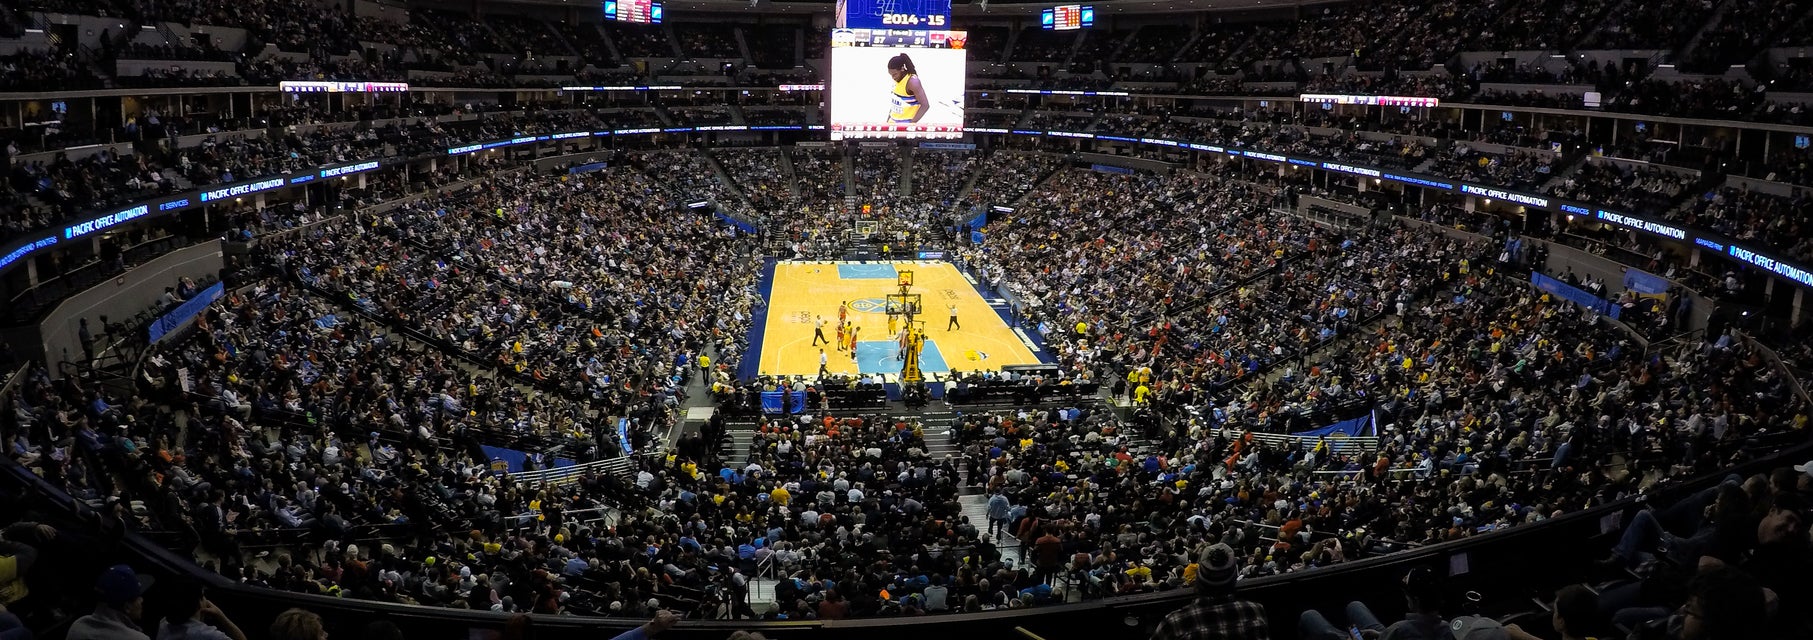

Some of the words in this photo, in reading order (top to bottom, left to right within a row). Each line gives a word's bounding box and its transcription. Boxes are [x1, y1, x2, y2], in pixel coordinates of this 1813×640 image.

[882, 14, 918, 25] 2014
[1354, 167, 1380, 176] AUTOMATION
[208, 189, 229, 200] PACIFIC
[230, 185, 249, 196] OFFICE
[249, 178, 284, 193] AUTOMATION
[1468, 186, 1487, 196] PACIFIC
[1488, 189, 1507, 200] OFFICE
[1508, 193, 1548, 207] AUTOMATION
[72, 221, 94, 236] PACIFIC
[95, 215, 114, 229] OFFICE
[114, 205, 148, 223] AUTOMATION
[1604, 212, 1624, 224] PACIFIC
[1624, 217, 1643, 229] OFFICE
[1644, 222, 1685, 239] AUTOMATION
[1735, 247, 1755, 263] PACIFIC
[1755, 254, 1774, 270] OFFICE
[1773, 262, 1813, 286] AUTOMATION
